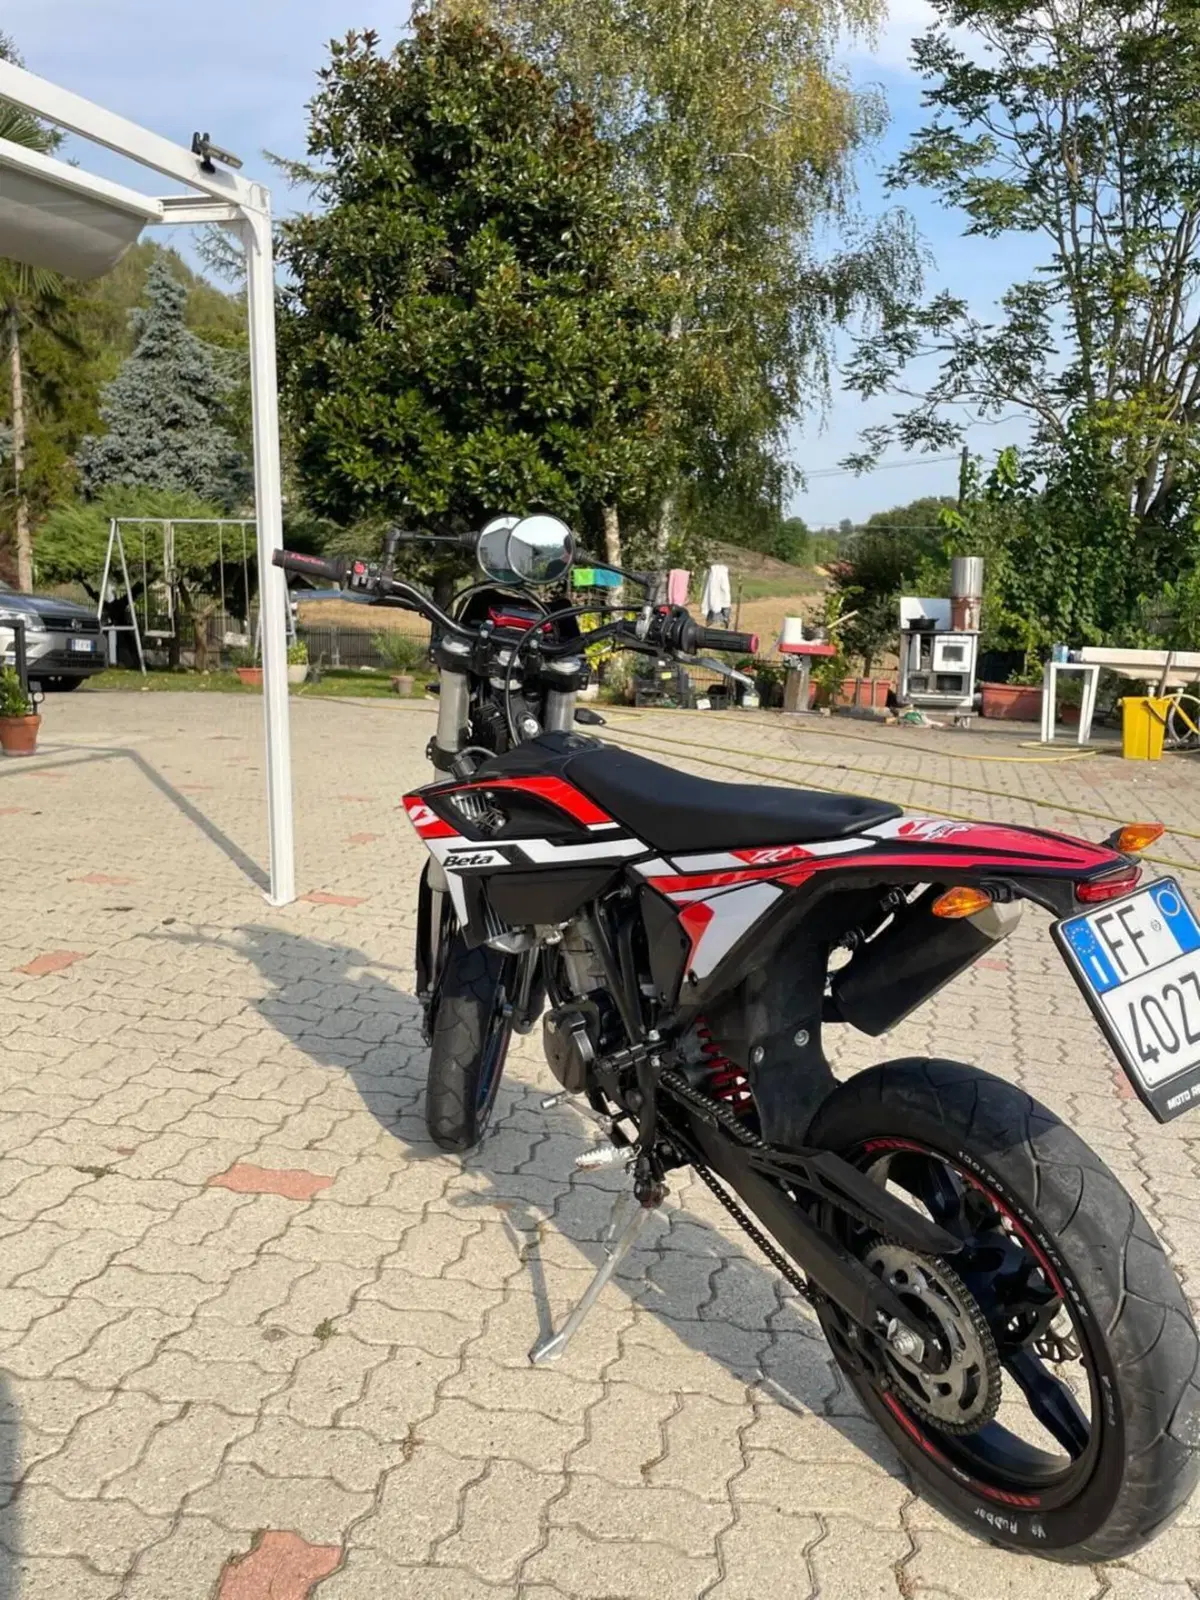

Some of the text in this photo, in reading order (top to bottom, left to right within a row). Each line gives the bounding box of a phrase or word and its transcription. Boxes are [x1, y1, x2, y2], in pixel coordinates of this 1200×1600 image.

[442, 853, 494, 867] Beta
[1094, 904, 1150, 976] FF
[1167, 1088, 1192, 1110] MOTO
